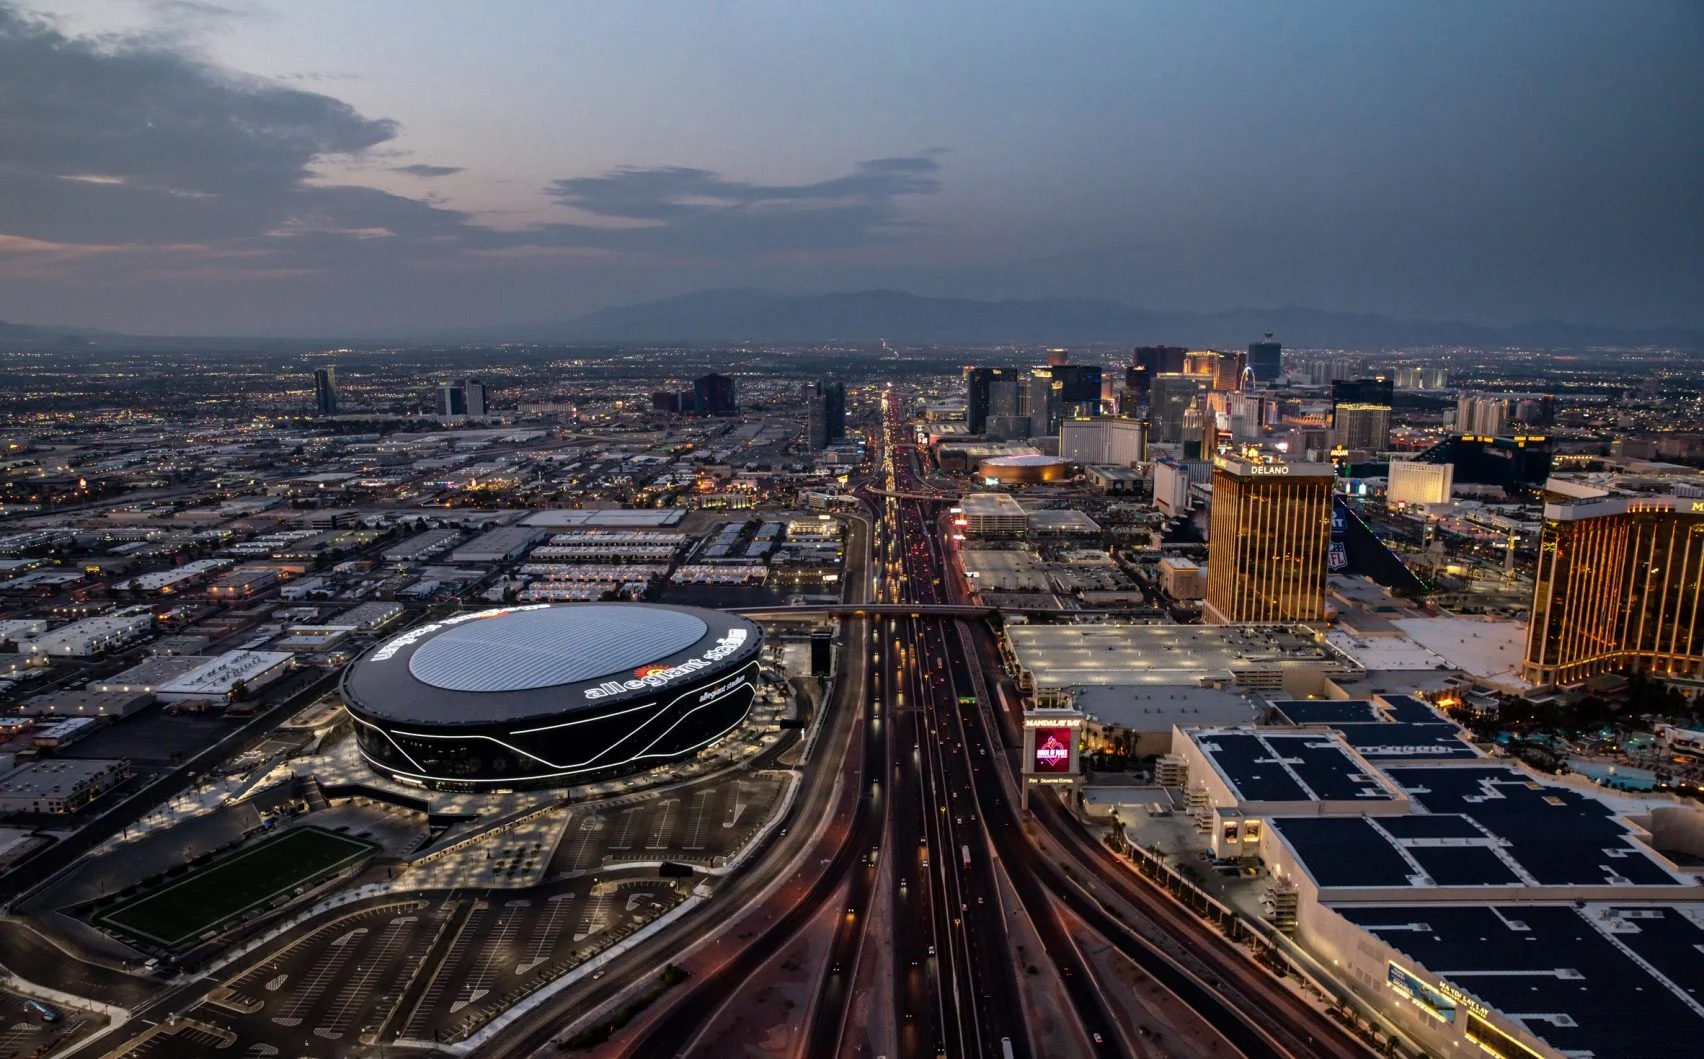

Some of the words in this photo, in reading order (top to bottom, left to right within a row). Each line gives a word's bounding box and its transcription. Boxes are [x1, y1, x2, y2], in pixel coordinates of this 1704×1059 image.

[1251, 466, 1289, 475] DELANO
[584, 658, 711, 699] allegiant
[1026, 719, 1066, 727] MANDALAY
[1067, 719, 1080, 727] BAY
